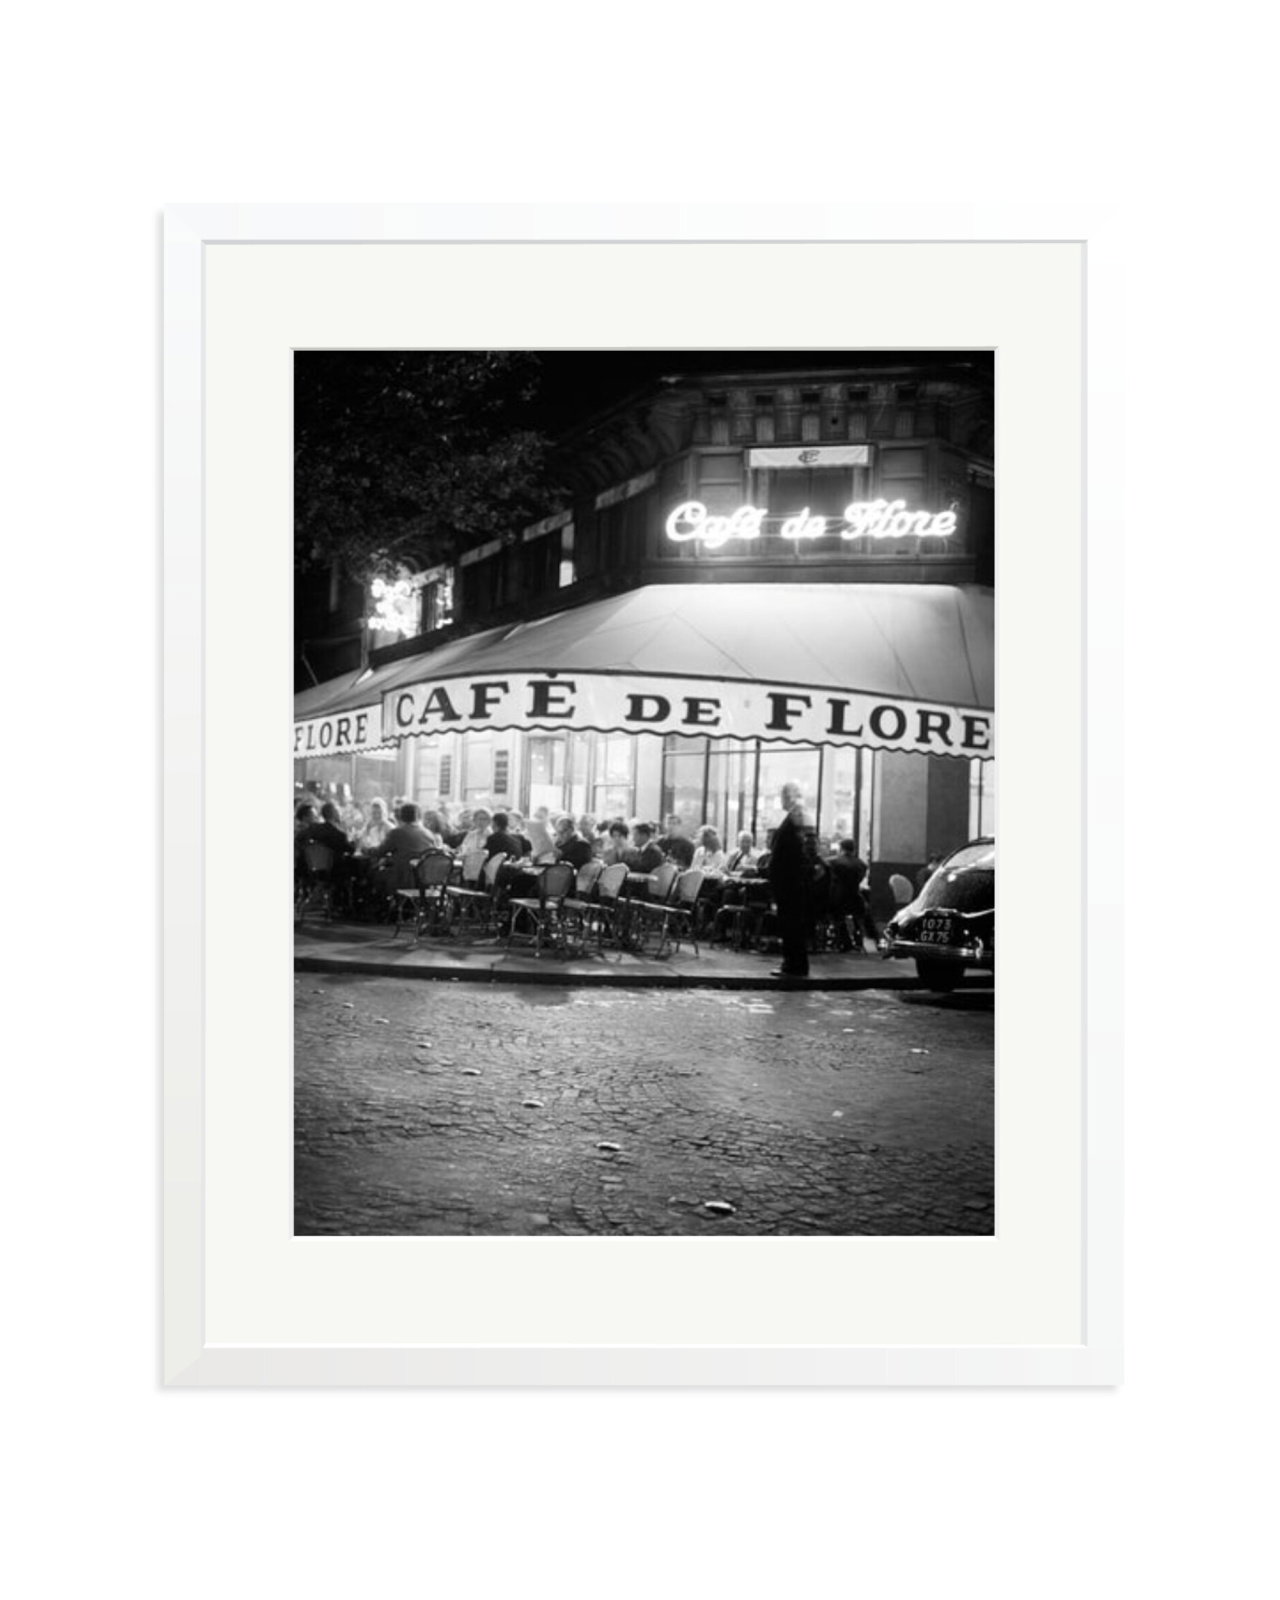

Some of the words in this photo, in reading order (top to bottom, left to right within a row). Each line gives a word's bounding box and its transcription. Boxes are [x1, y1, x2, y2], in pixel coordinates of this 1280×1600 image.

[781, 507, 826, 539] de
[841, 499, 957, 540] Flore
[294, 713, 368, 751] FLORE
[625, 693, 721, 726] DE
[765, 692, 991, 750] FLORE
